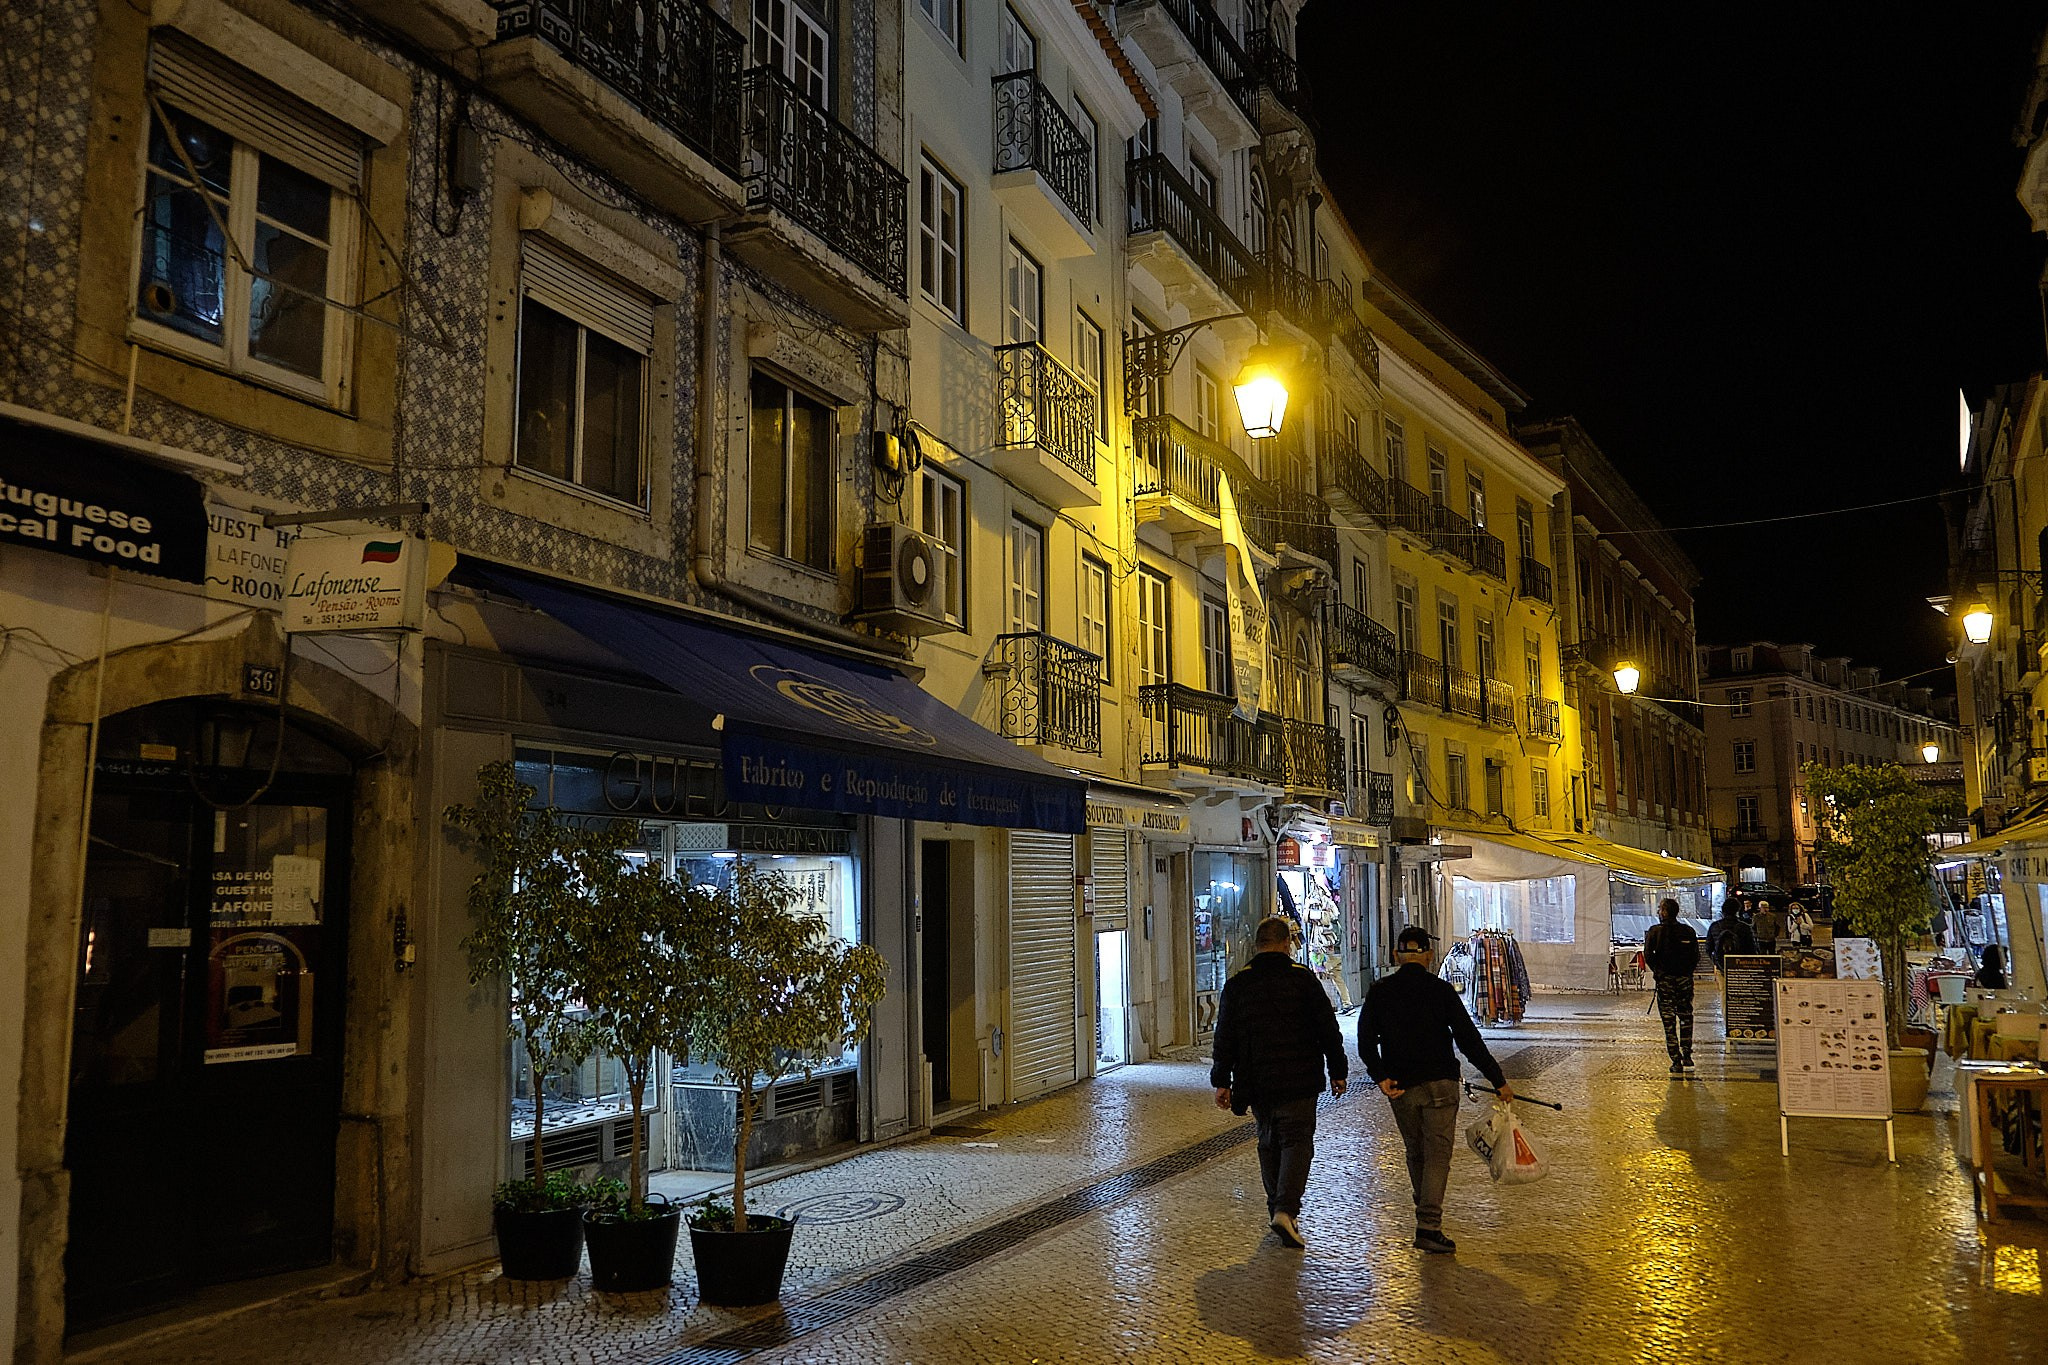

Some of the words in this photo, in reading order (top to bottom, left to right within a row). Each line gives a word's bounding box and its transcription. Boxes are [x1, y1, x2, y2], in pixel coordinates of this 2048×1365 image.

[0, 512, 58, 541] cal
[72, 525, 160, 564] Food
[288, 571, 382, 606] Lafonense
[317, 597, 357, 614] Pensão
[365, 595, 400, 612] Rooms
[321, 614, 335, 624] 351
[250, 669, 273, 692] 36
[741, 755, 805, 789] Fabrico
[821, 774, 832, 793] e
[845, 769, 929, 807] Reprodução
[940, 781, 957, 807] de
[1086, 804, 1124, 825] SOUVENIR
[1142, 811, 1180, 831] ARTESANATO
[235, 871, 253, 881] DE
[216, 886, 256, 895] GUEST
